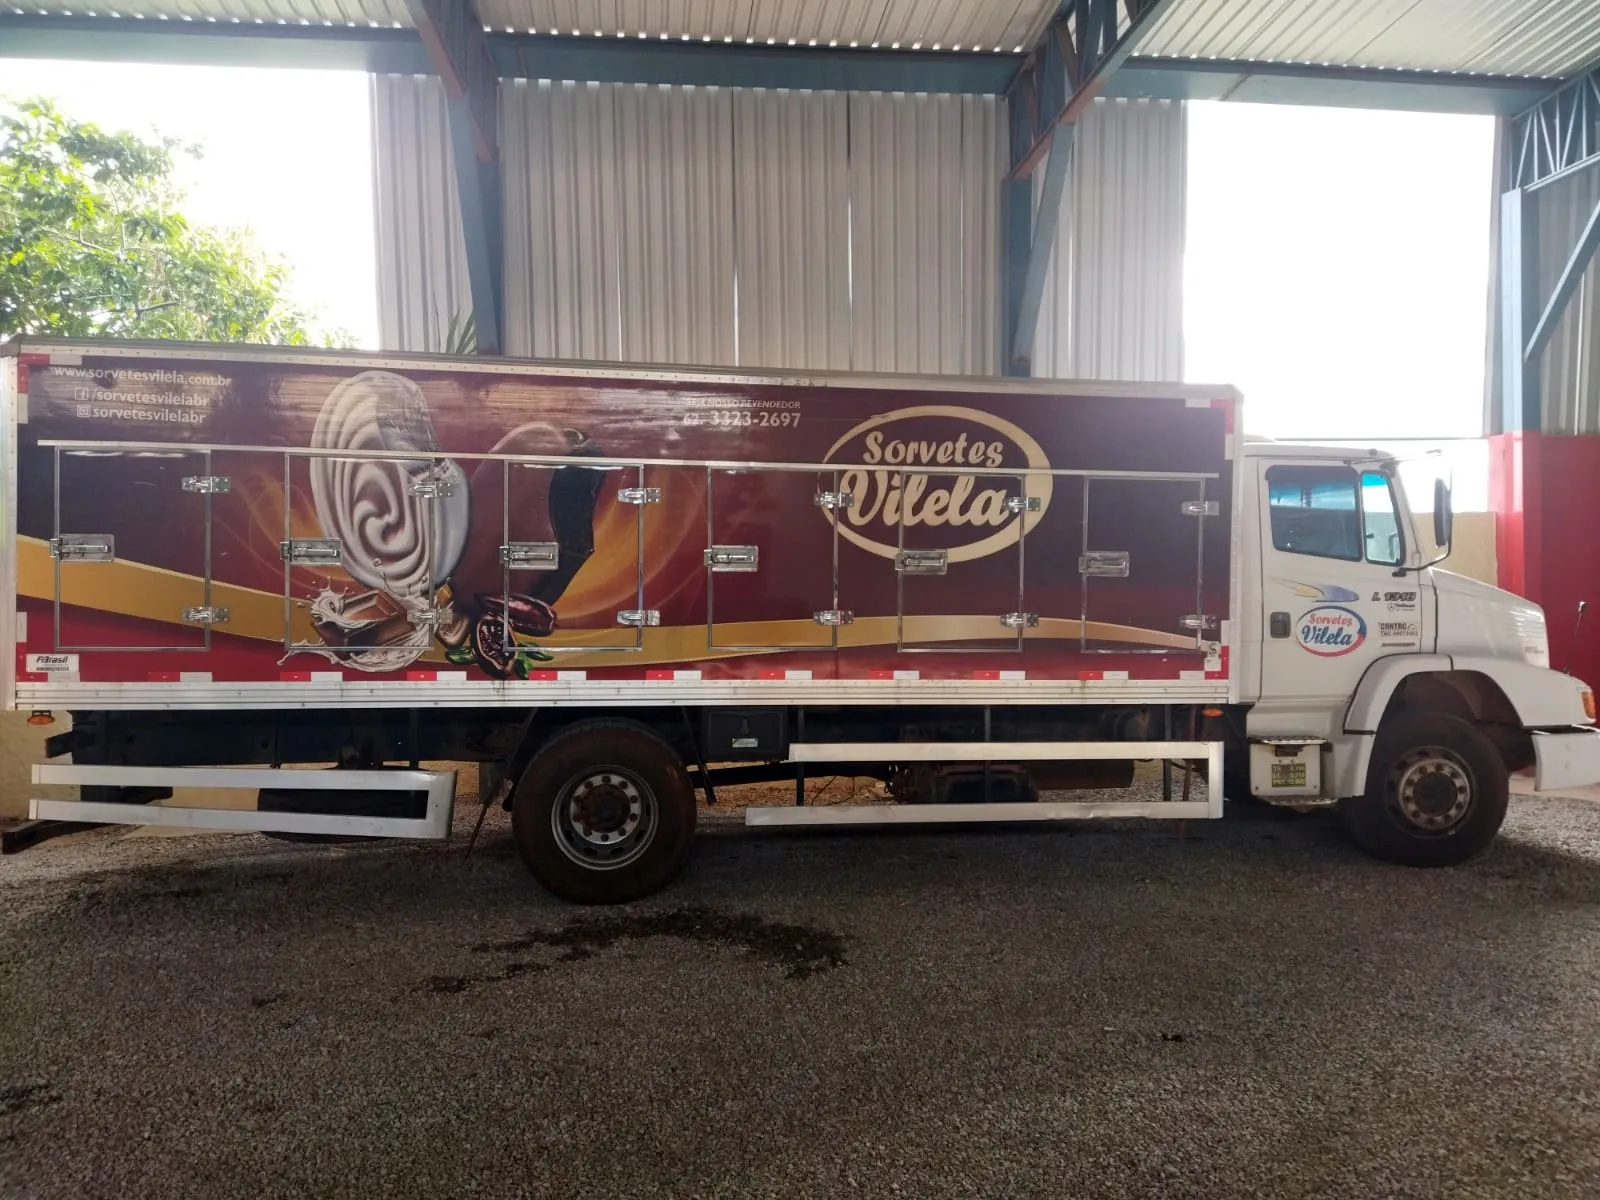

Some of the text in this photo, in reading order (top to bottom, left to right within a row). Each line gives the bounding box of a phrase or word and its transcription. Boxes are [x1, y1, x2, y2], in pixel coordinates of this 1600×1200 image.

[54, 367, 232, 386] www.sorvetesvilela.com.br
[740, 399, 801, 409] REVENDEDOR
[93, 408, 206, 424] sorvetesvilelabr
[708, 410, 801, 428] 3323-2697
[862, 431, 1004, 468] Sorvetes
[840, 468, 1010, 527] Vilela
[1308, 613, 1353, 626] Sorvetes
[1301, 624, 1353, 646] Vilela
